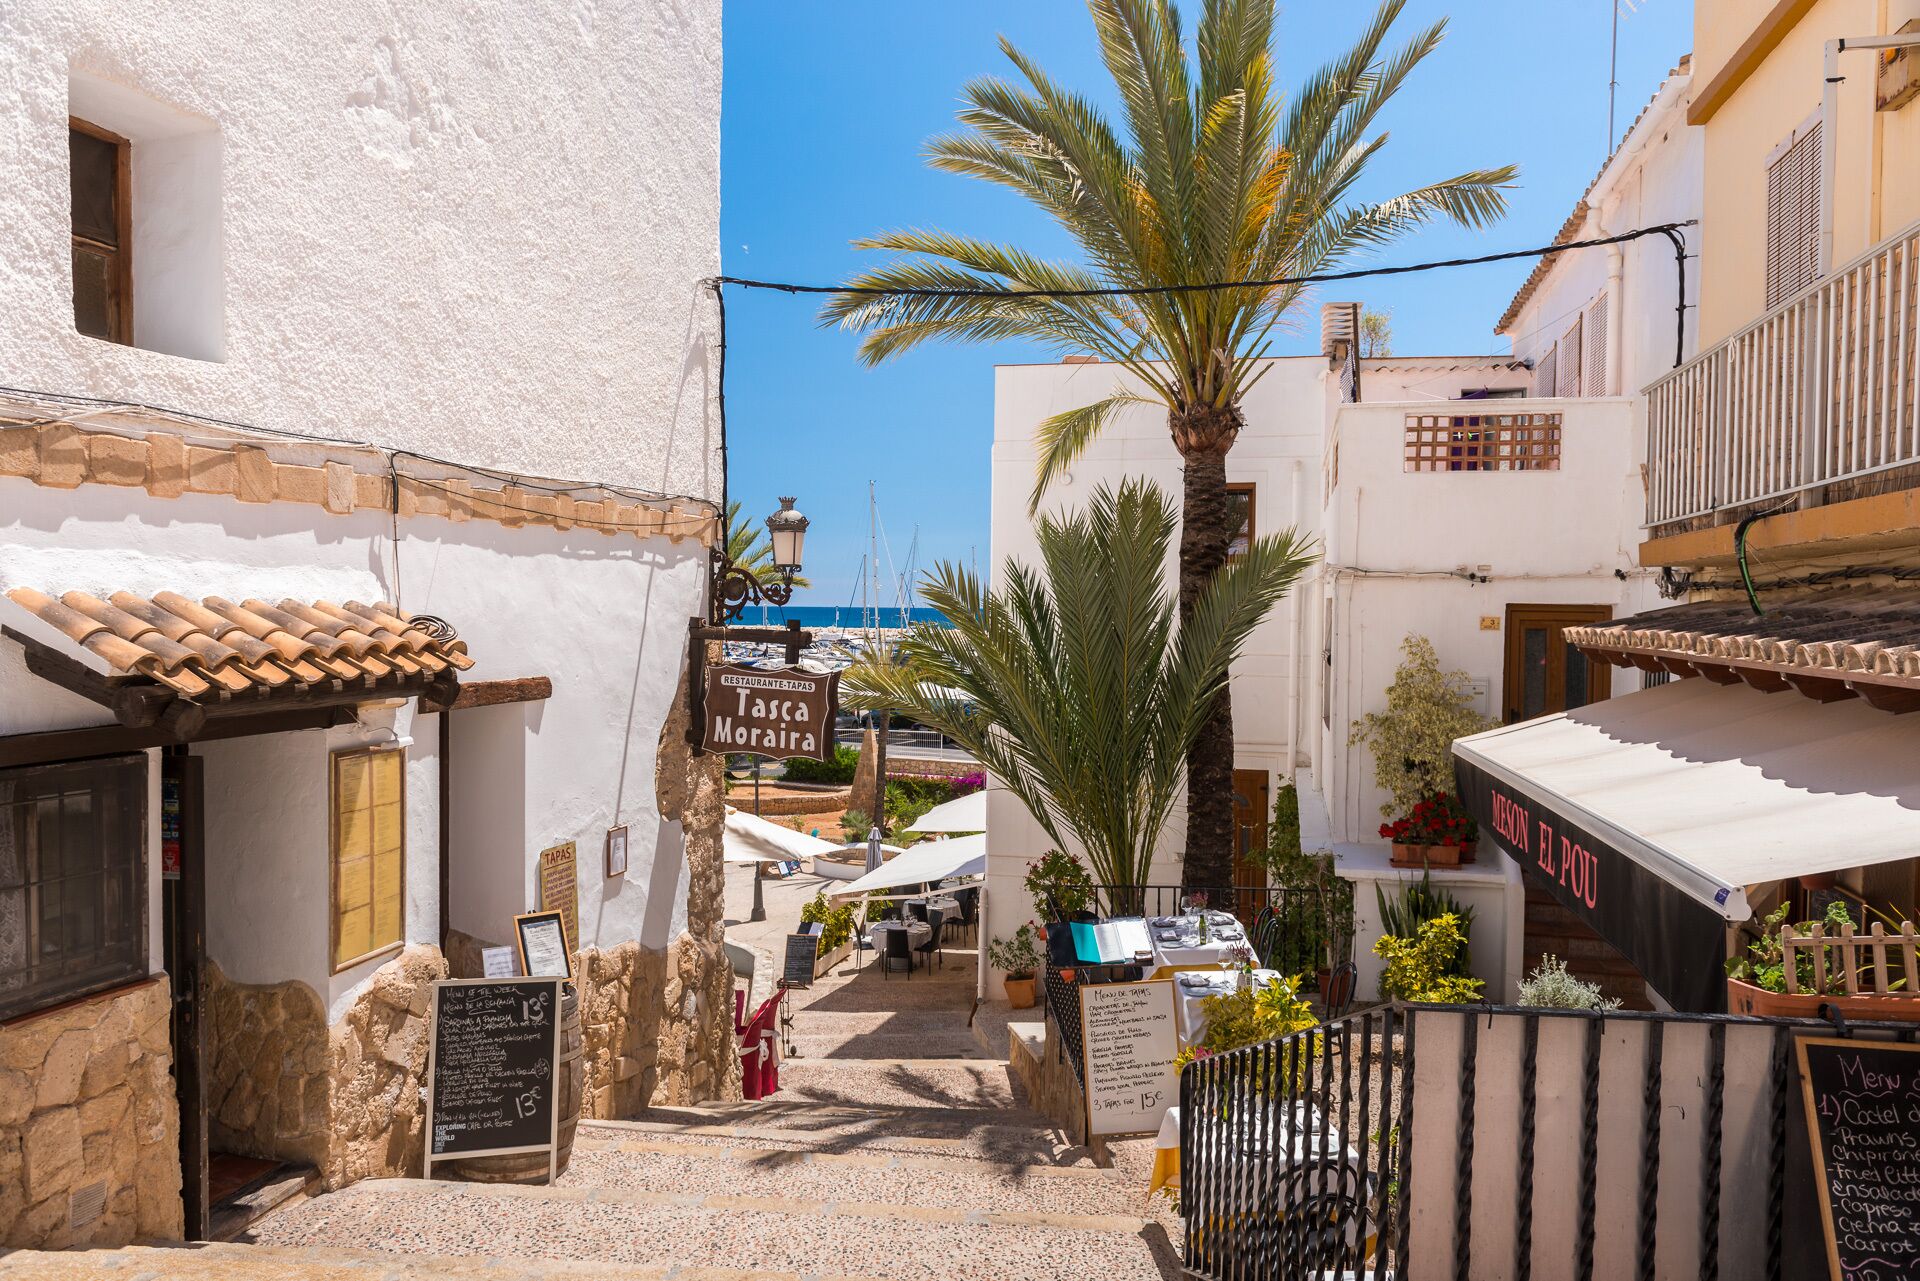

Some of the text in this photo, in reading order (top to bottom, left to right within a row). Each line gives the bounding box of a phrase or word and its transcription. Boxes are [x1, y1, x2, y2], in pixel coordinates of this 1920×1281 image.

[724, 676, 813, 691] RESTAURANTE-TAPAS
[736, 687, 809, 722] Tasca
[714, 716, 815, 752] Moraira
[545, 847, 571, 866] TAPAS
[1492, 790, 1598, 909] MESON EL POU
[1837, 1054, 1900, 1090] Menu
[1094, 1100, 1101, 1111] 3
[1141, 1091, 1164, 1110] 15€
[1843, 1098, 1900, 1125] Coctel
[1839, 1217, 1906, 1233] Crema
